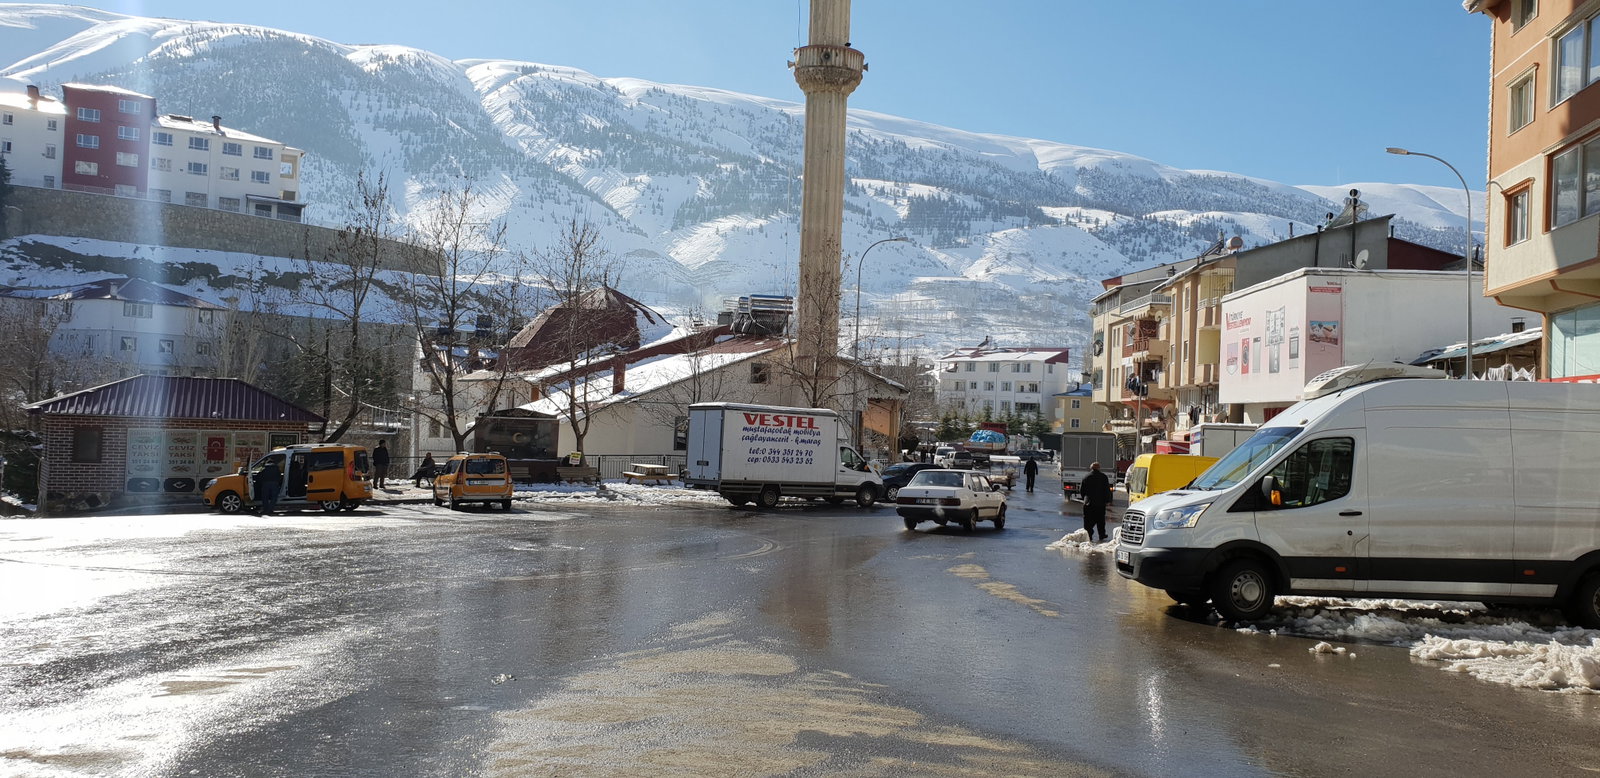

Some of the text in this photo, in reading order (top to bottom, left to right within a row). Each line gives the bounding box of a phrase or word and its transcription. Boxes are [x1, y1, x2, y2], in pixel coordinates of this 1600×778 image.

[743, 412, 820, 430] VESTEL
[793, 428, 821, 438] mobilya
[767, 448, 781, 456] 344
[782, 448, 794, 456] 351
[795, 449, 803, 457] 24
[804, 449, 814, 457] 70
[762, 456, 780, 464] 0533
[781, 456, 794, 464] 543
[795, 457, 804, 465] 23
